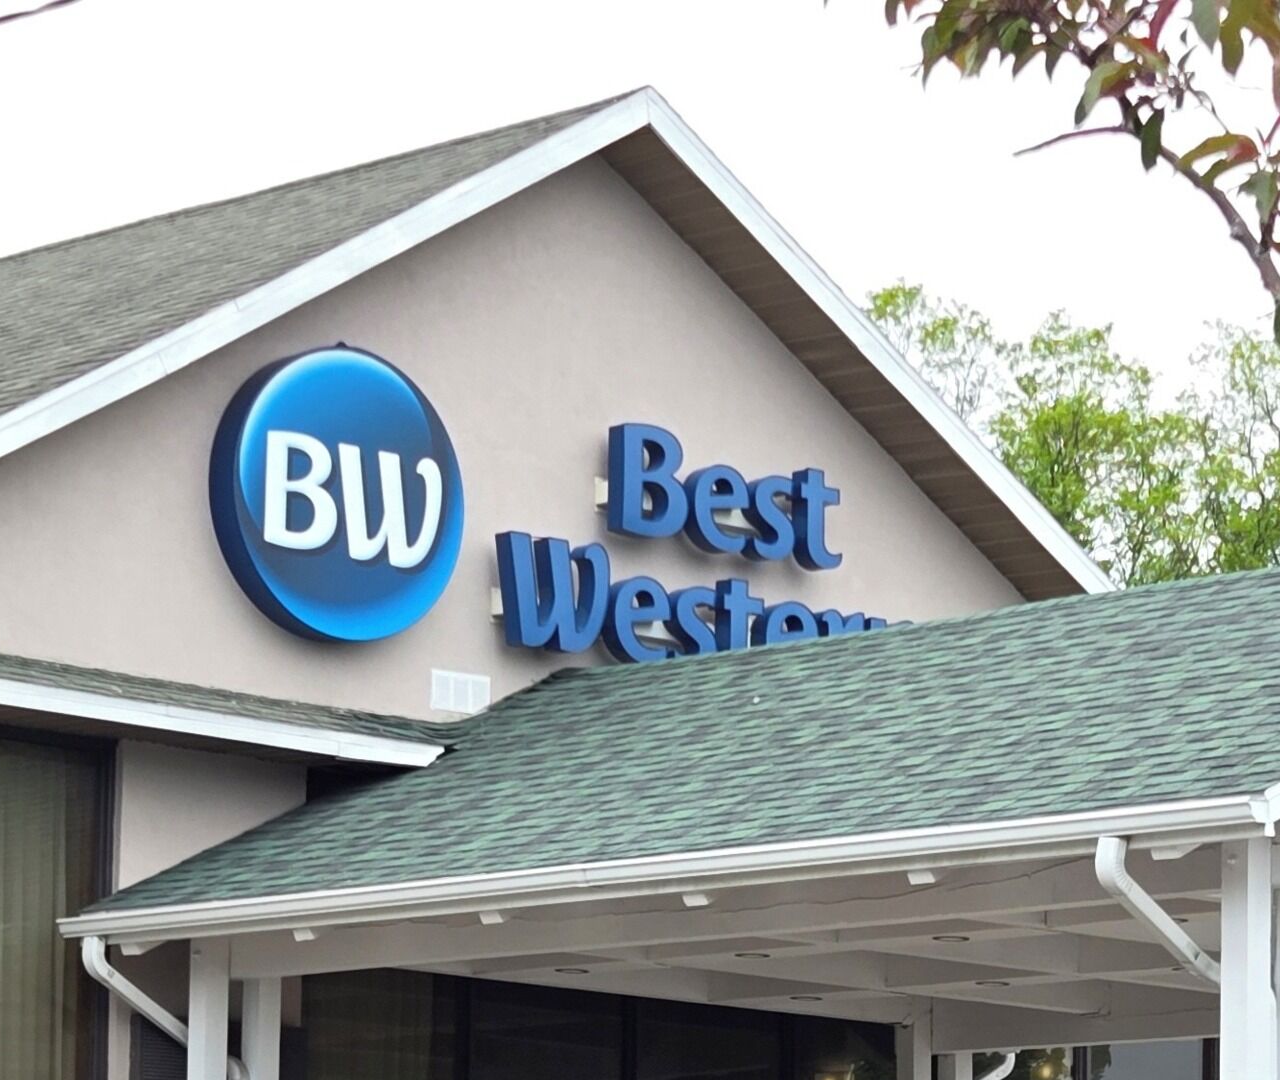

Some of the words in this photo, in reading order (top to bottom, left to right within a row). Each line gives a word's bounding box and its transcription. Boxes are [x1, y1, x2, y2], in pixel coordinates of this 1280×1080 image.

[262, 429, 443, 569] BW
[607, 422, 843, 571] Best
[495, 530, 916, 664] Weste
